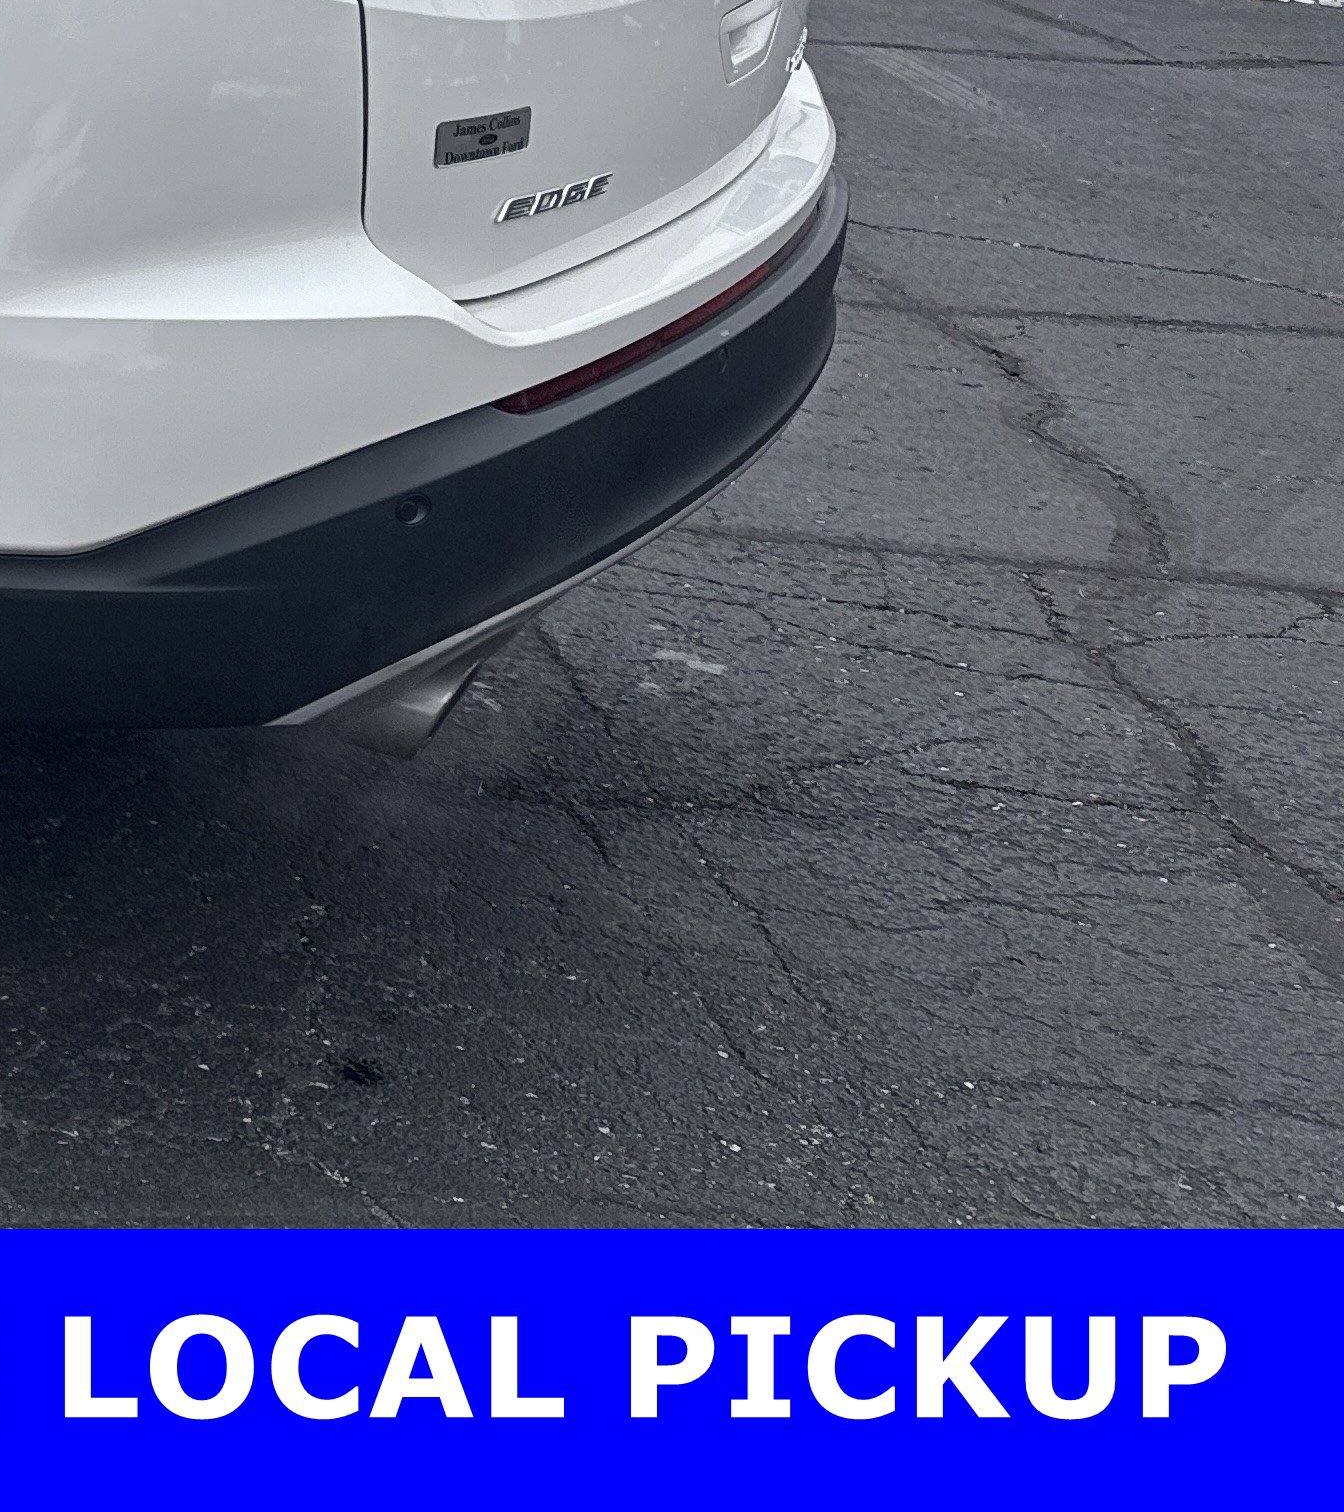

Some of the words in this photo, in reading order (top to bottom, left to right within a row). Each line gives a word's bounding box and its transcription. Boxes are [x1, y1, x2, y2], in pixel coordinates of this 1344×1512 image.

[453, 123, 487, 137] James
[489, 115, 521, 131] Collins
[445, 147, 500, 165] Downtown
[501, 136, 525, 155] Ford
[494, 171, 613, 224] EDGE
